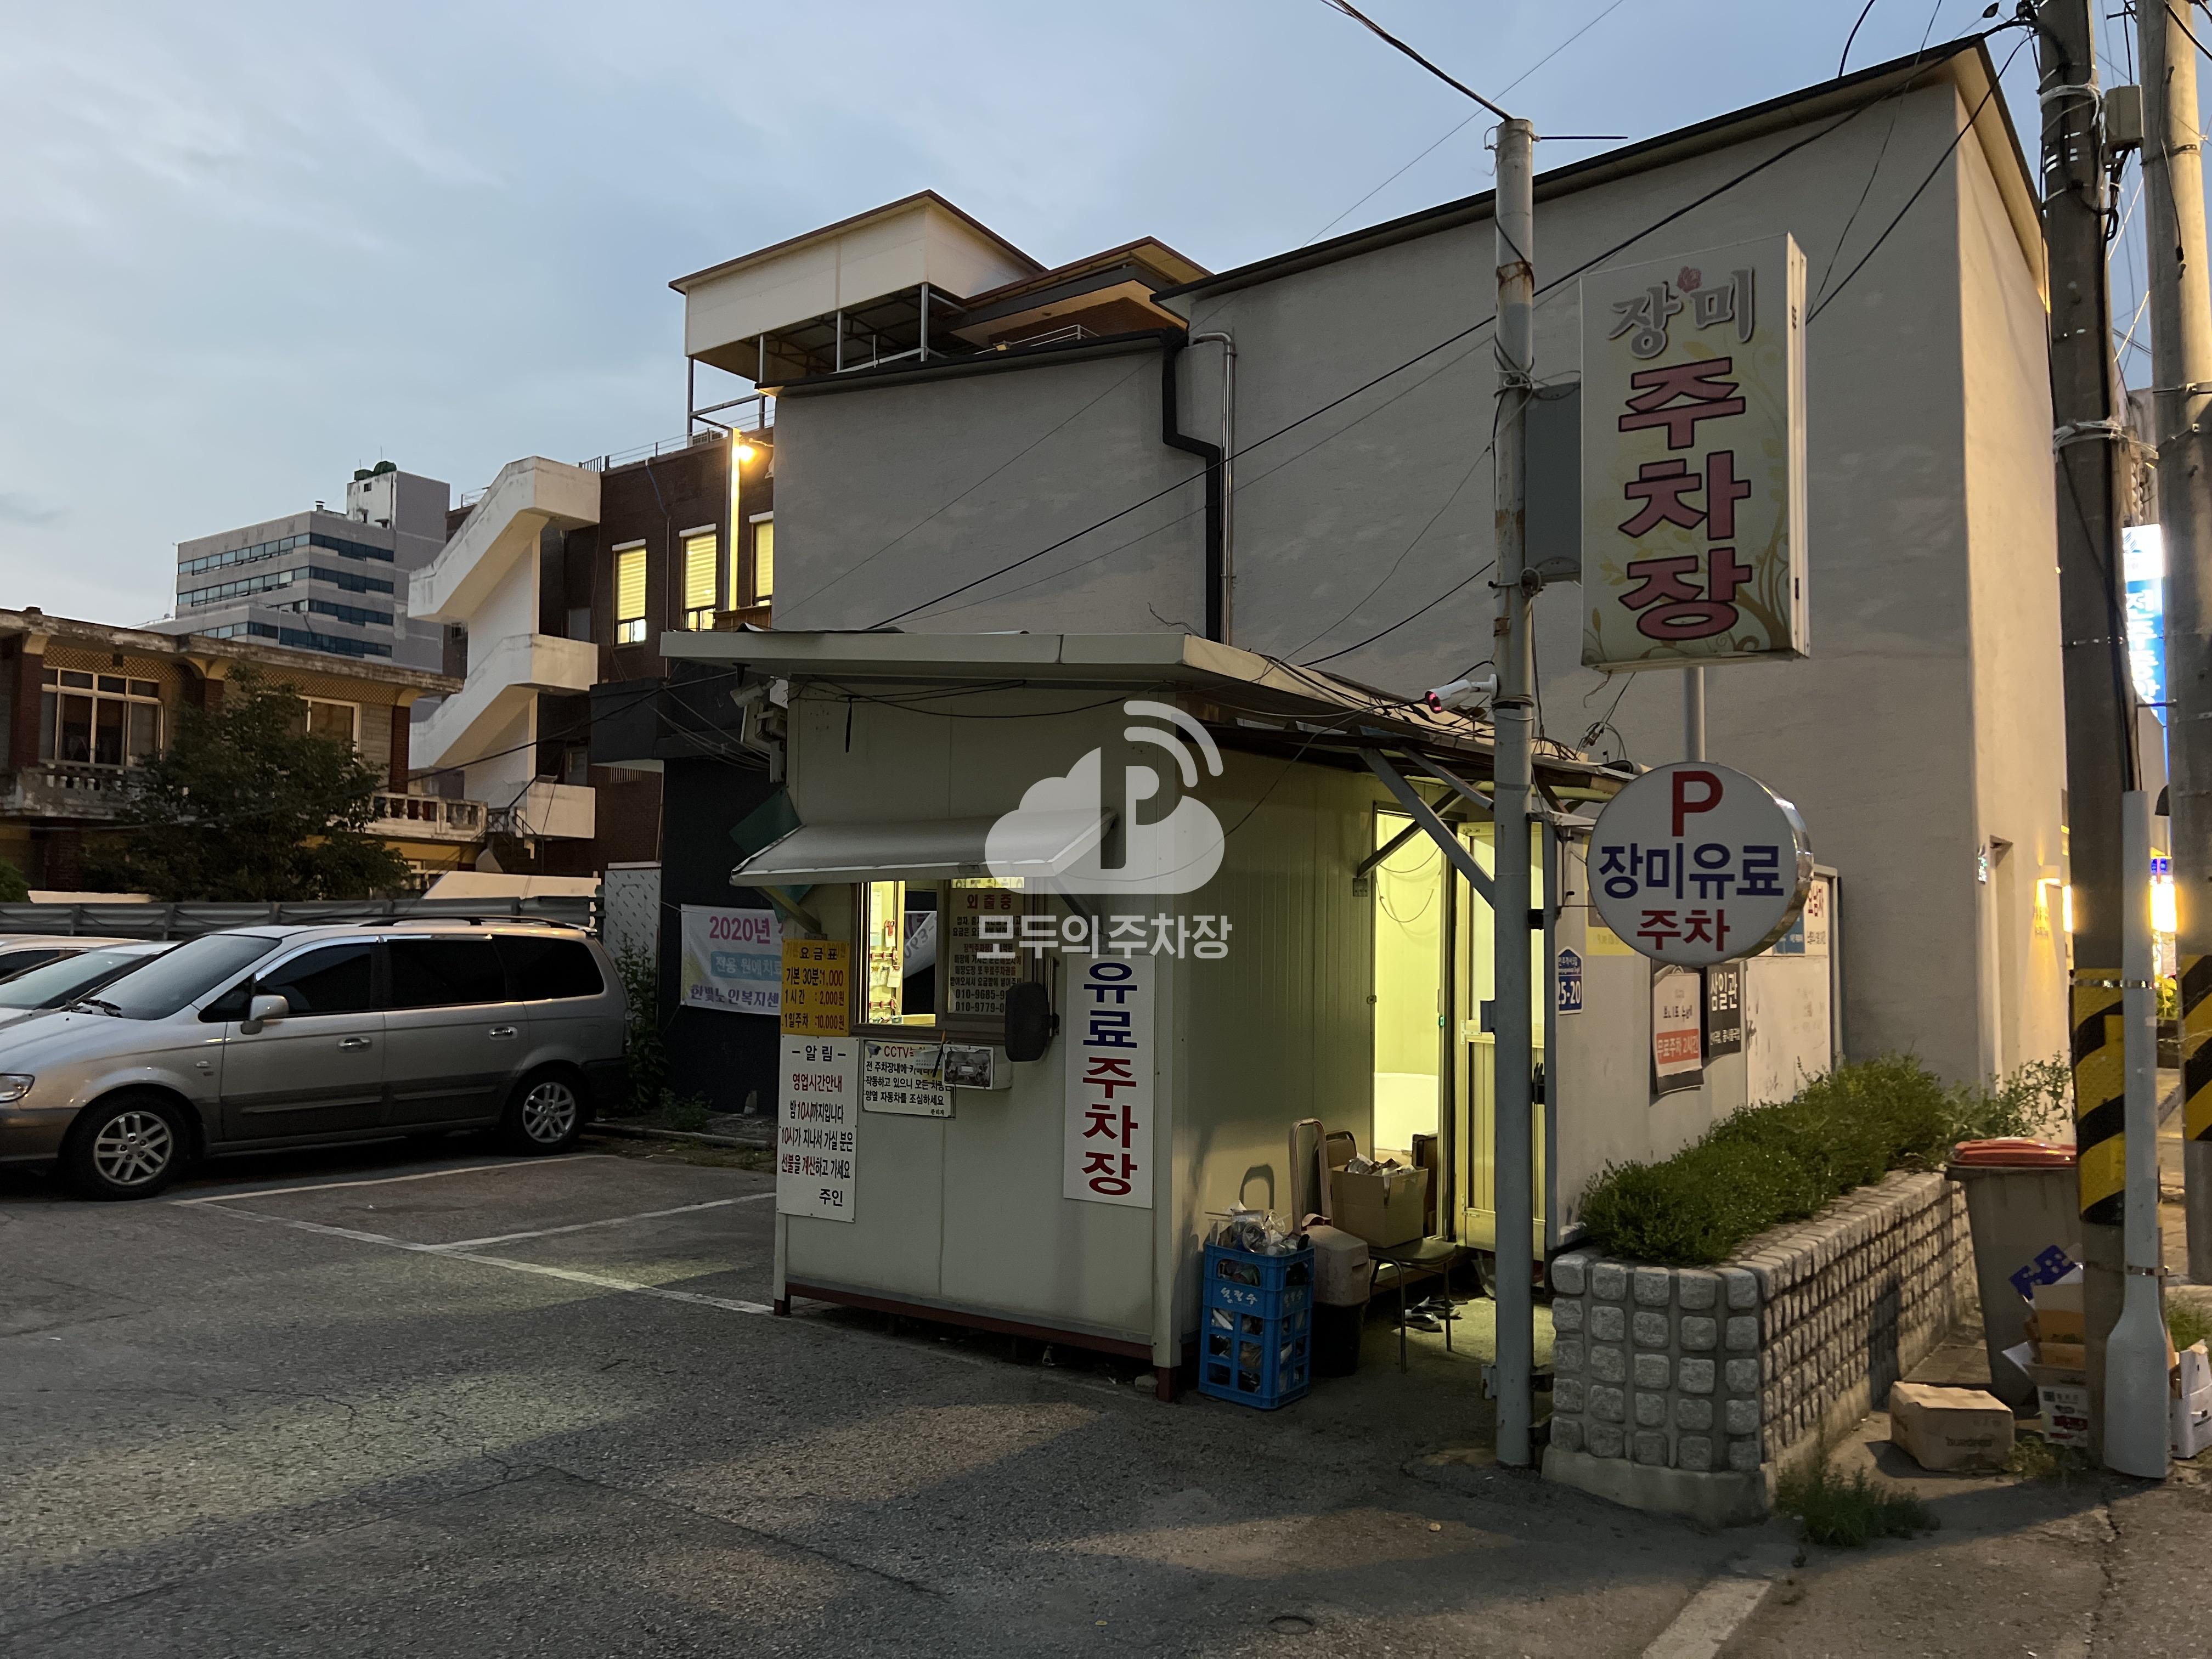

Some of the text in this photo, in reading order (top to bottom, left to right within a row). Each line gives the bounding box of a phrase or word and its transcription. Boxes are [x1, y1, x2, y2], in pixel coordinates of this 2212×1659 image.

[1607, 267, 1756, 359] 장미
[1618, 357, 1753, 641] 주차장
[1672, 770, 1723, 837] P
[1599, 843, 1784, 900] 장미유료
[709, 916, 770, 944] 2020년
[1637, 909, 1730, 952] 주차
[787, 967, 800, 985] 기본
[785, 1013, 809, 1029] 1일주차
[793, 1073, 843, 1093] 영업시간안내
[866, 1076, 890, 1087] 작동하고
[894, 1077, 912, 1089] 있으니
[881, 1092, 907, 1104] 자동차를
[910, 1093, 944, 1106] 조심하세요
[782, 1127, 853, 1152] 10시가 지나서 가실 분은
[802, 1156, 828, 1177] 계산하고
[831, 1159, 850, 1180] 가세요
[819, 1188, 843, 1207] 주인
